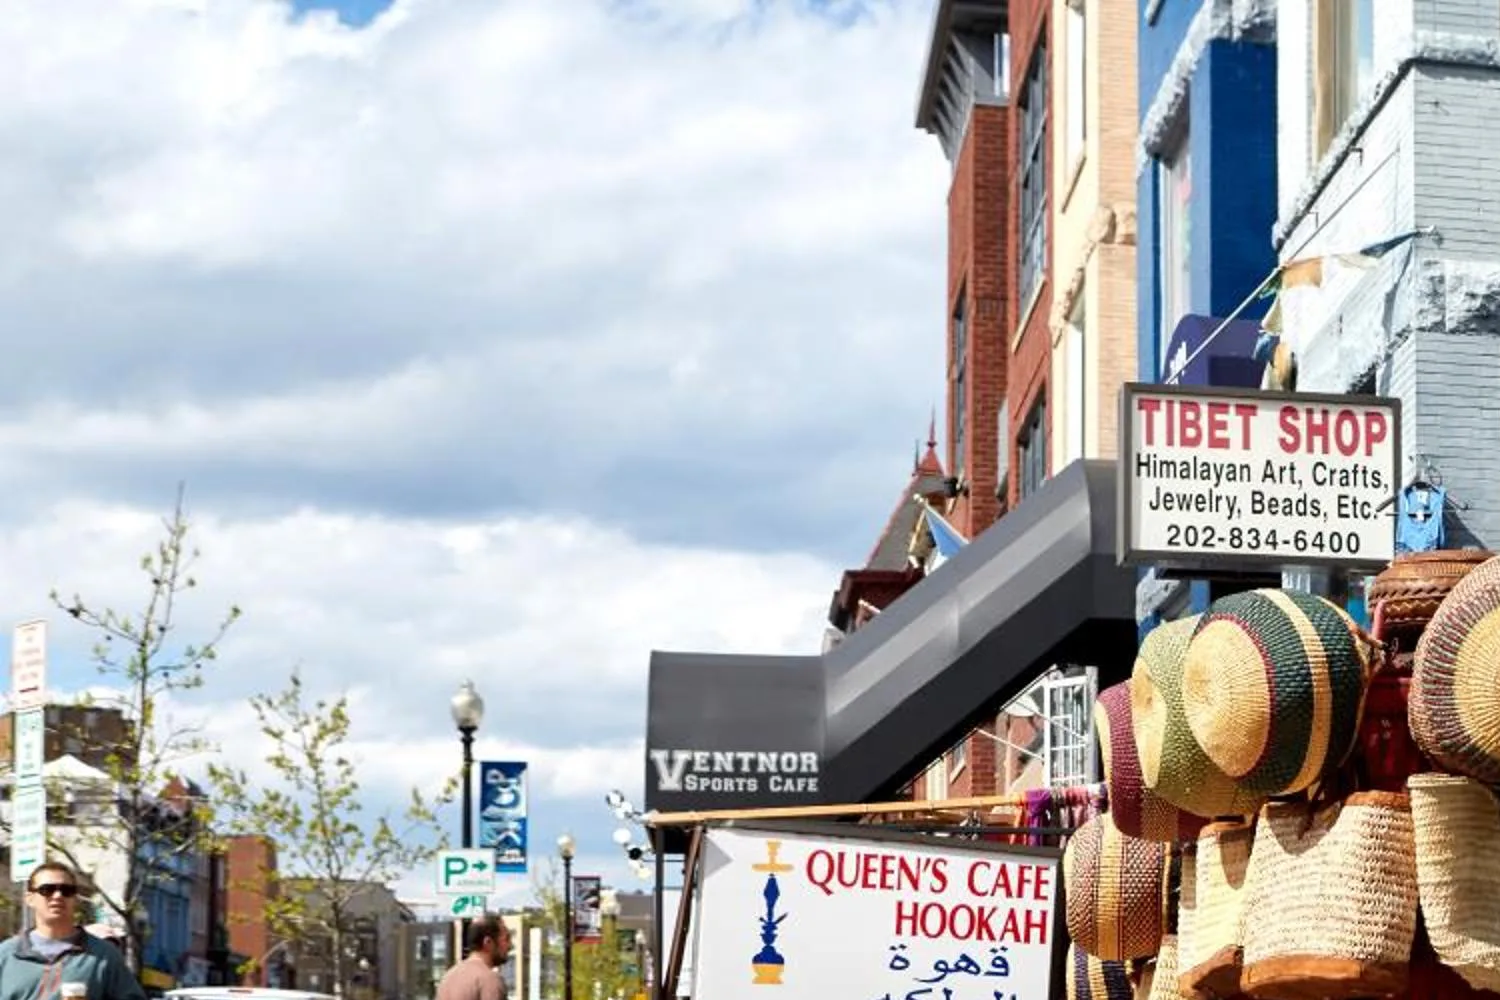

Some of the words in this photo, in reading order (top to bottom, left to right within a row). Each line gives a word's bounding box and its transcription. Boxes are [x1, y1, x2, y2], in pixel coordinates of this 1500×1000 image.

[1137, 397, 1258, 450] TIBET
[1278, 405, 1388, 457] SHOP
[1136, 453, 1251, 488] Himalayan
[1261, 459, 1303, 490] Art,
[1312, 461, 1389, 493] Crafts,
[1148, 486, 1241, 520] Jewelry,
[1251, 490, 1329, 522] Beads,
[1337, 495, 1379, 520] Etc.
[1166, 524, 1361, 554] 202-834-6400
[650, 749, 819, 791] VENTNOR
[684, 774, 758, 792] SPORTS
[769, 774, 818, 792] CAFE
[445, 856, 468, 886] P
[806, 849, 948, 896] QUEEN'S
[967, 861, 1049, 900] CAFE
[895, 901, 1048, 944] HOOKAH
[889, 944, 1010, 983] قهوة
